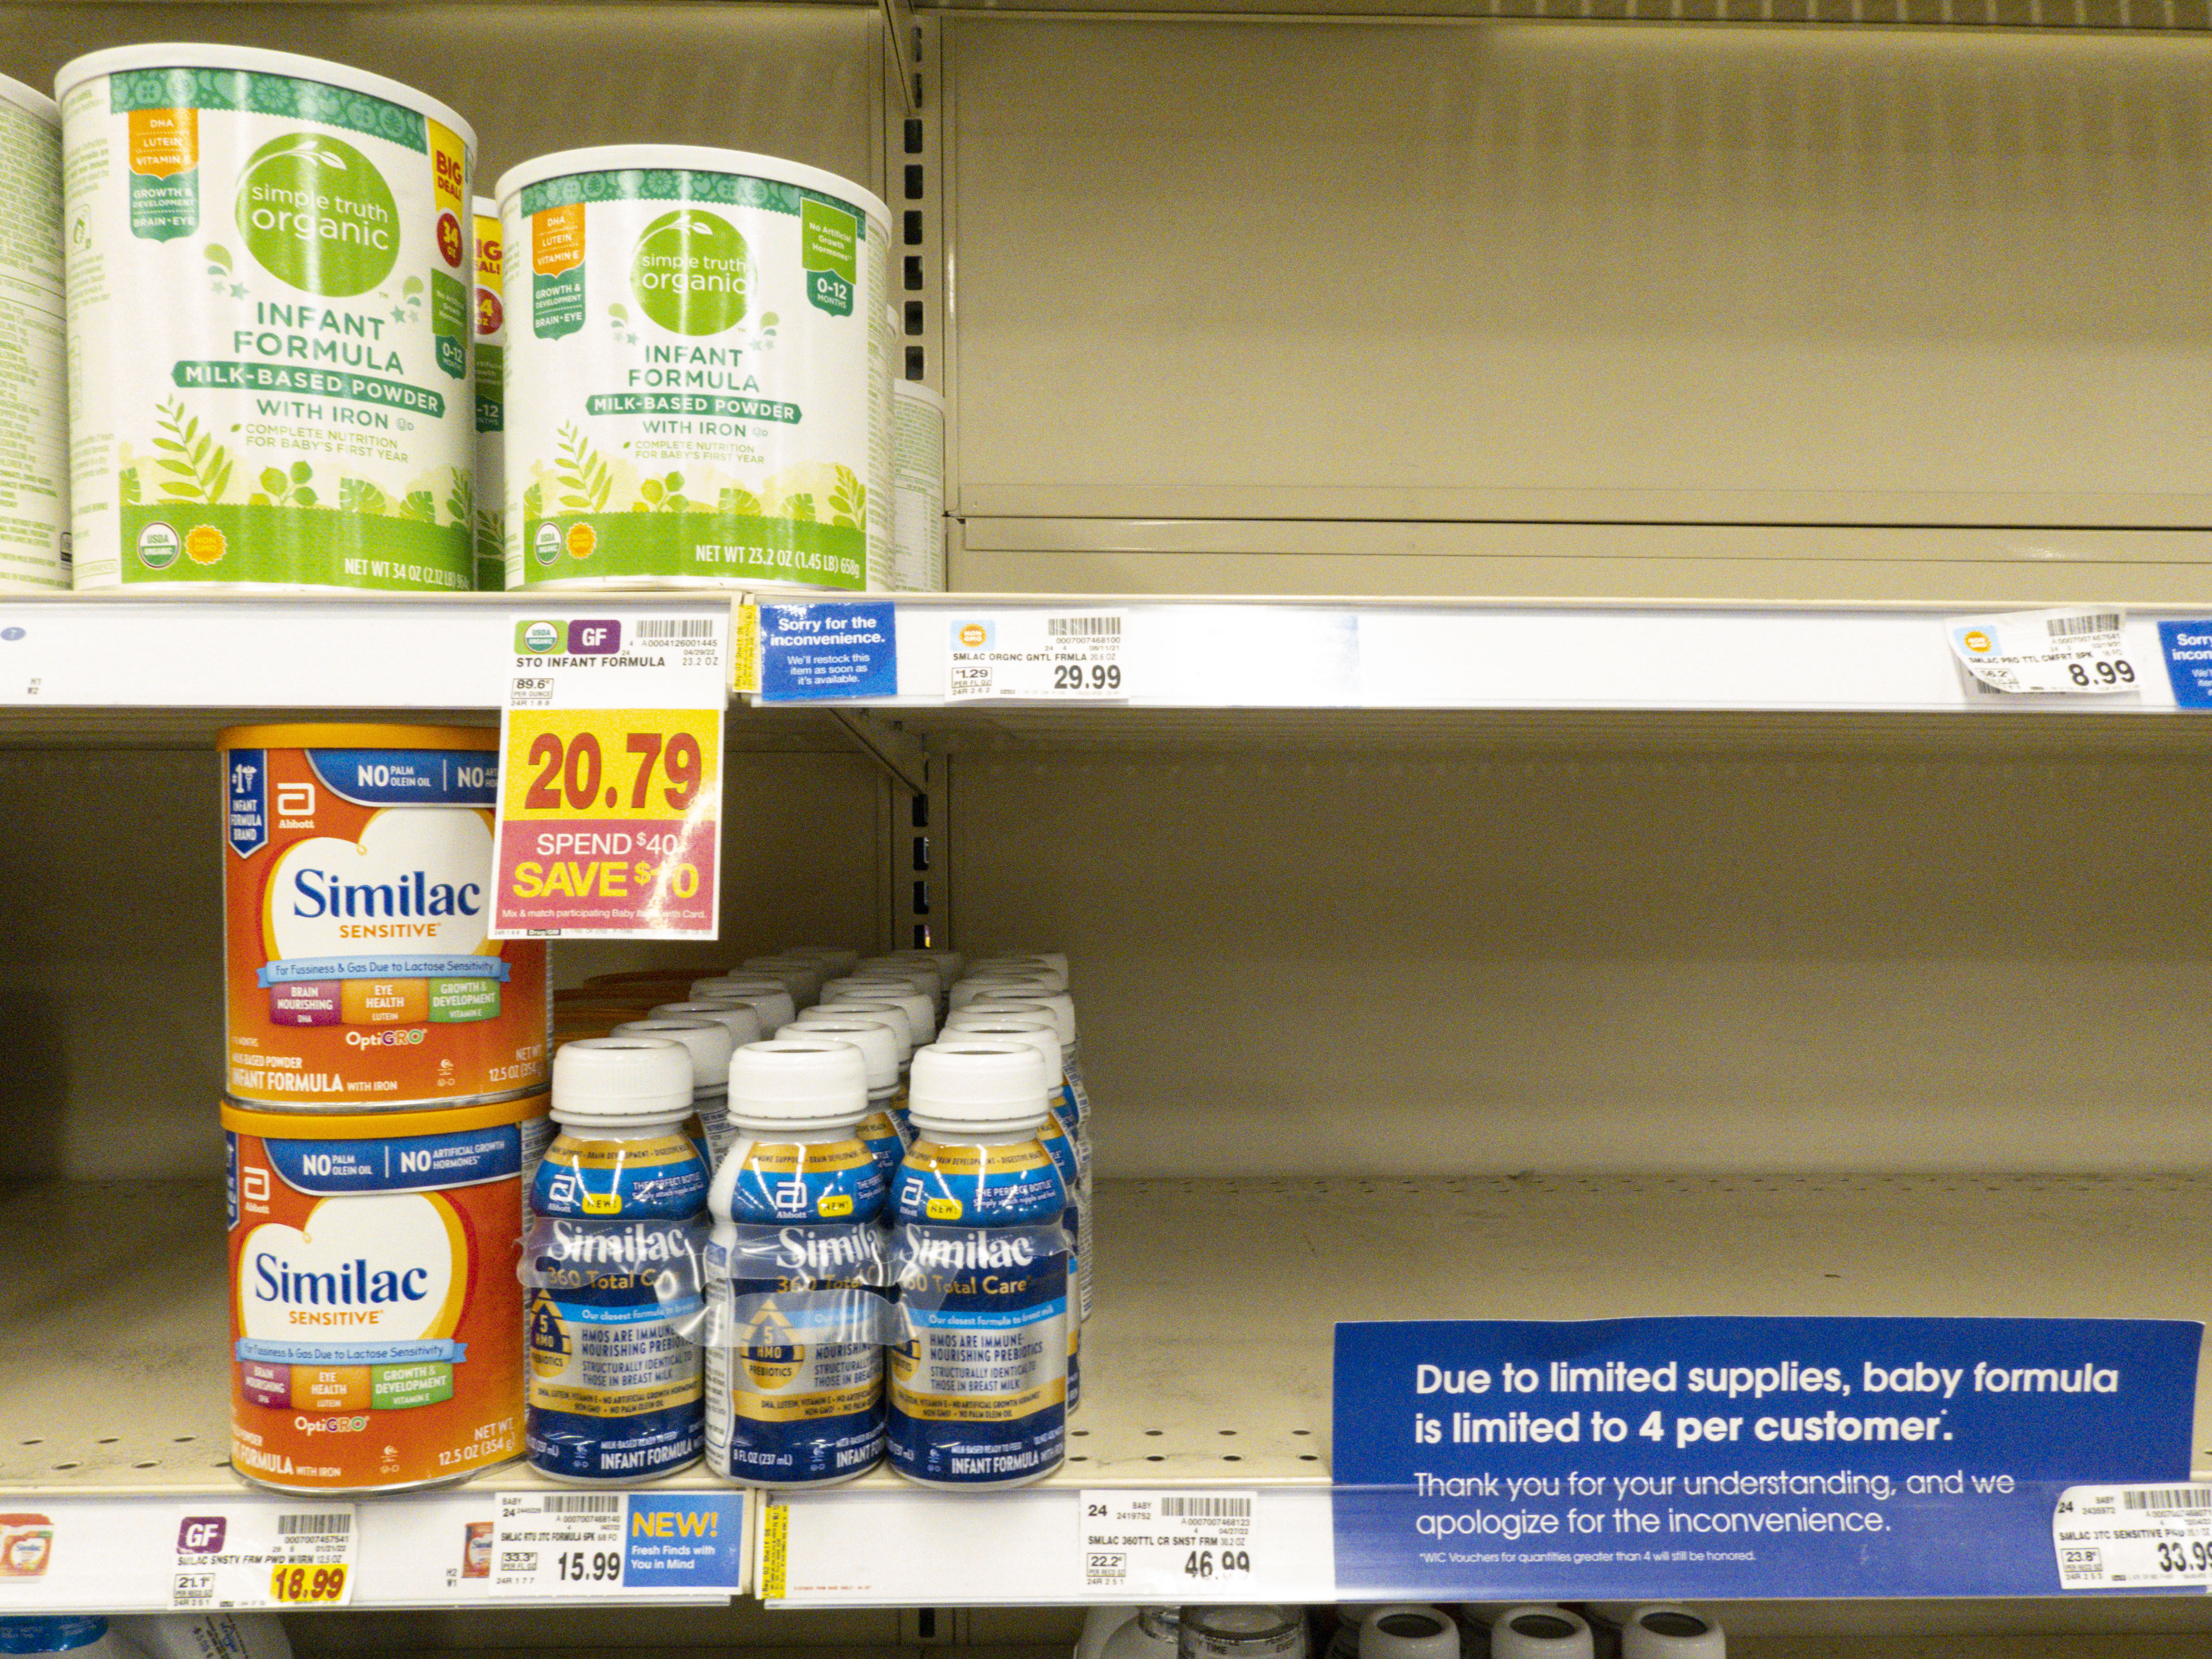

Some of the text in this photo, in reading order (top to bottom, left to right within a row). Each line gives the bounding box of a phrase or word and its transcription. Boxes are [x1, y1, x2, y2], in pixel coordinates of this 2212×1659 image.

[252, 183, 389, 224] simple truth
[252, 208, 389, 251] organic
[642, 251, 746, 274] simple truth
[642, 269, 748, 296] organic
[817, 277, 847, 301] 0-12
[257, 302, 385, 340] INFANT
[234, 330, 404, 375] FORMULA
[645, 345, 743, 367] INFANT
[186, 366, 439, 413] MILK-BASED POWDER
[628, 368, 759, 393] FORMULA
[256, 399, 389, 429] WITH IRON
[594, 396, 794, 420] MILK-BASED POWDER
[246, 423, 323, 439] COMPLETE
[642, 420, 746, 438] WITH IRON
[635, 440, 755, 454] COMPLETE NUTRITION
[696, 544, 793, 567] NET WT 23.2 OZ
[344, 557, 390, 578] NET WT
[778, 616, 877, 633] Sorry for the
[581, 627, 608, 647] GF
[770, 632, 885, 646] inconvenience.
[516, 657, 718, 667] STO INFANT FORMULA OZ
[787, 653, 870, 665] We'll restock this
[953, 653, 985, 662] SMLAC
[1026, 653, 1051, 662] GNTL
[790, 667, 812, 676] item
[828, 666, 854, 674] soon
[797, 674, 860, 685] it's available.
[1054, 664, 1121, 690] 29.99
[2068, 659, 2135, 686] 8.99
[358, 765, 484, 789] NO NO
[524, 732, 702, 810] 20.79
[537, 831, 678, 855] SPEND $40
[512, 861, 629, 898] SAVE
[293, 868, 481, 919] Similac
[556, 910, 609, 919] participating
[611, 909, 635, 919] Baby
[340, 923, 438, 938] SENSITIVE
[290, 962, 446, 975] Fussiness Gas Due Lactose
[374, 985, 393, 995] EYE
[365, 997, 405, 1008] HEALTH
[267, 1071, 398, 1093] FORMULA WITH IRON
[303, 1150, 431, 1176] NO NO
[547, 1219, 686, 1263] Similac
[900, 1223, 1034, 1270] Similac
[255, 1252, 429, 1306] Similac
[586, 1270, 635, 1289] Total
[931, 1275, 1027, 1295] Total Care
[289, 1309, 384, 1327] SENSITIVE
[613, 1328, 633, 1343] ARE
[960, 1333, 1022, 1347] ARE IMMUNE
[582, 1342, 646, 1357] NOURISHING
[929, 1347, 991, 1363] NOURISHING
[319, 1371, 336, 1382] EYE
[375, 1375, 447, 1394] DEVELOPMENT
[384, 1367, 426, 1381] GROWTH
[1416, 1361, 2119, 1399] Due to limited supplies, baby formula
[311, 1384, 348, 1395] HEALTH
[1415, 1413, 1442, 1444] is
[1453, 1411, 1581, 1443] limited
[1590, 1411, 1628, 1443] to
[1639, 1411, 1665, 1443] 4
[1676, 1416, 1743, 1450] per
[601, 1437, 693, 1470] INFANT FORMULA
[836, 1444, 871, 1468] INFANT
[952, 1450, 1039, 1474] INFANT FORMULA
[1414, 1470, 2015, 1501] Thank you for your understanding, and we
[502, 1508, 516, 1517] 24
[1088, 1504, 1108, 1517] 24
[1132, 1501, 1152, 1510] BABY
[2058, 1501, 2074, 1514] 24
[631, 1511, 718, 1538] NEW!
[1416, 1507, 1891, 1541] apologize for the inconvenience.
[2112, 1529, 2163, 1540] SENSITIVE
[186, 1524, 219, 1547] GF
[1088, 1536, 1218, 1546] SMLAC SNST FRM
[630, 1545, 715, 1555] Fresh Finds with
[1448, 1551, 1756, 1565] Vouchers for quantities greater than will still be honored.
[558, 1551, 621, 1581] 15.99
[630, 1558, 695, 1569] You in Mind
[1185, 1550, 1250, 1579] 46.99
[275, 1568, 344, 1600] 18.99
